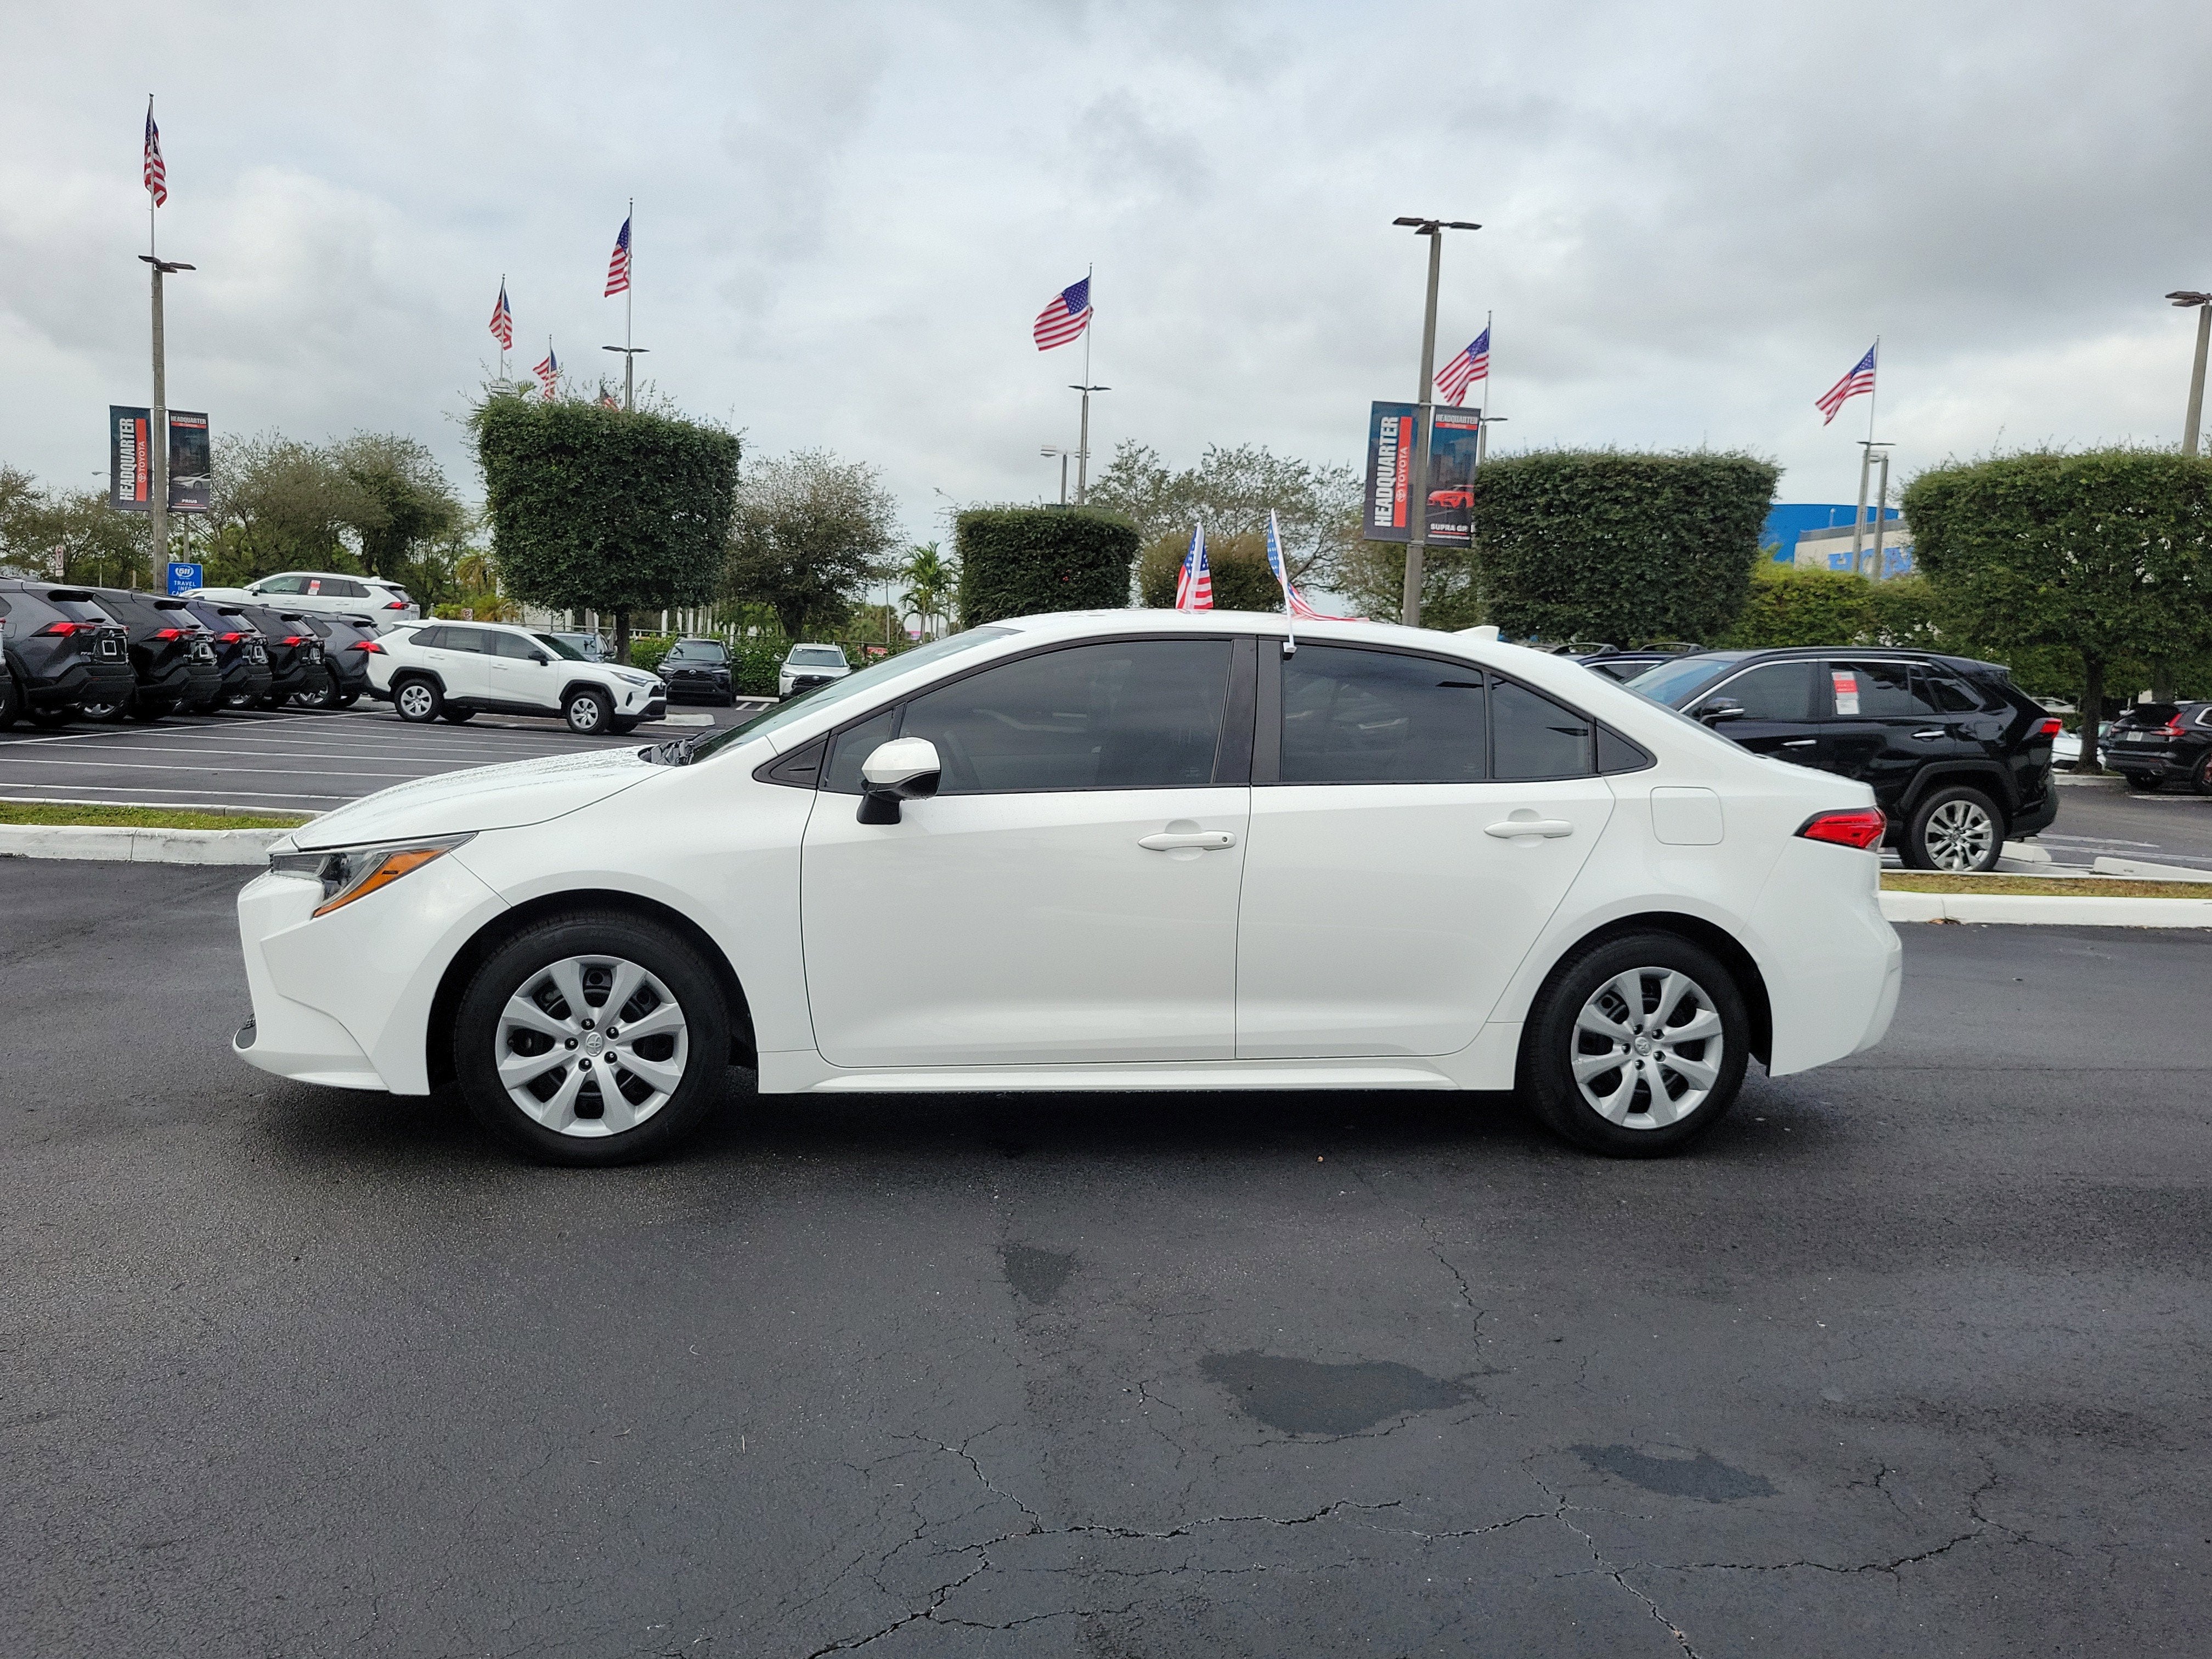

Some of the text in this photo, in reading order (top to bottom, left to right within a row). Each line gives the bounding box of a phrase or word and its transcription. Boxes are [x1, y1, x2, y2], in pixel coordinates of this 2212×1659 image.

[171, 416, 206, 424] HEADQUARTER
[120, 418, 137, 500] HEADQUARTER
[1374, 416, 1399, 527] HEADQUARTER
[1397, 447, 1409, 488] TOYOTA
[1430, 523, 1456, 531] SUPRA
